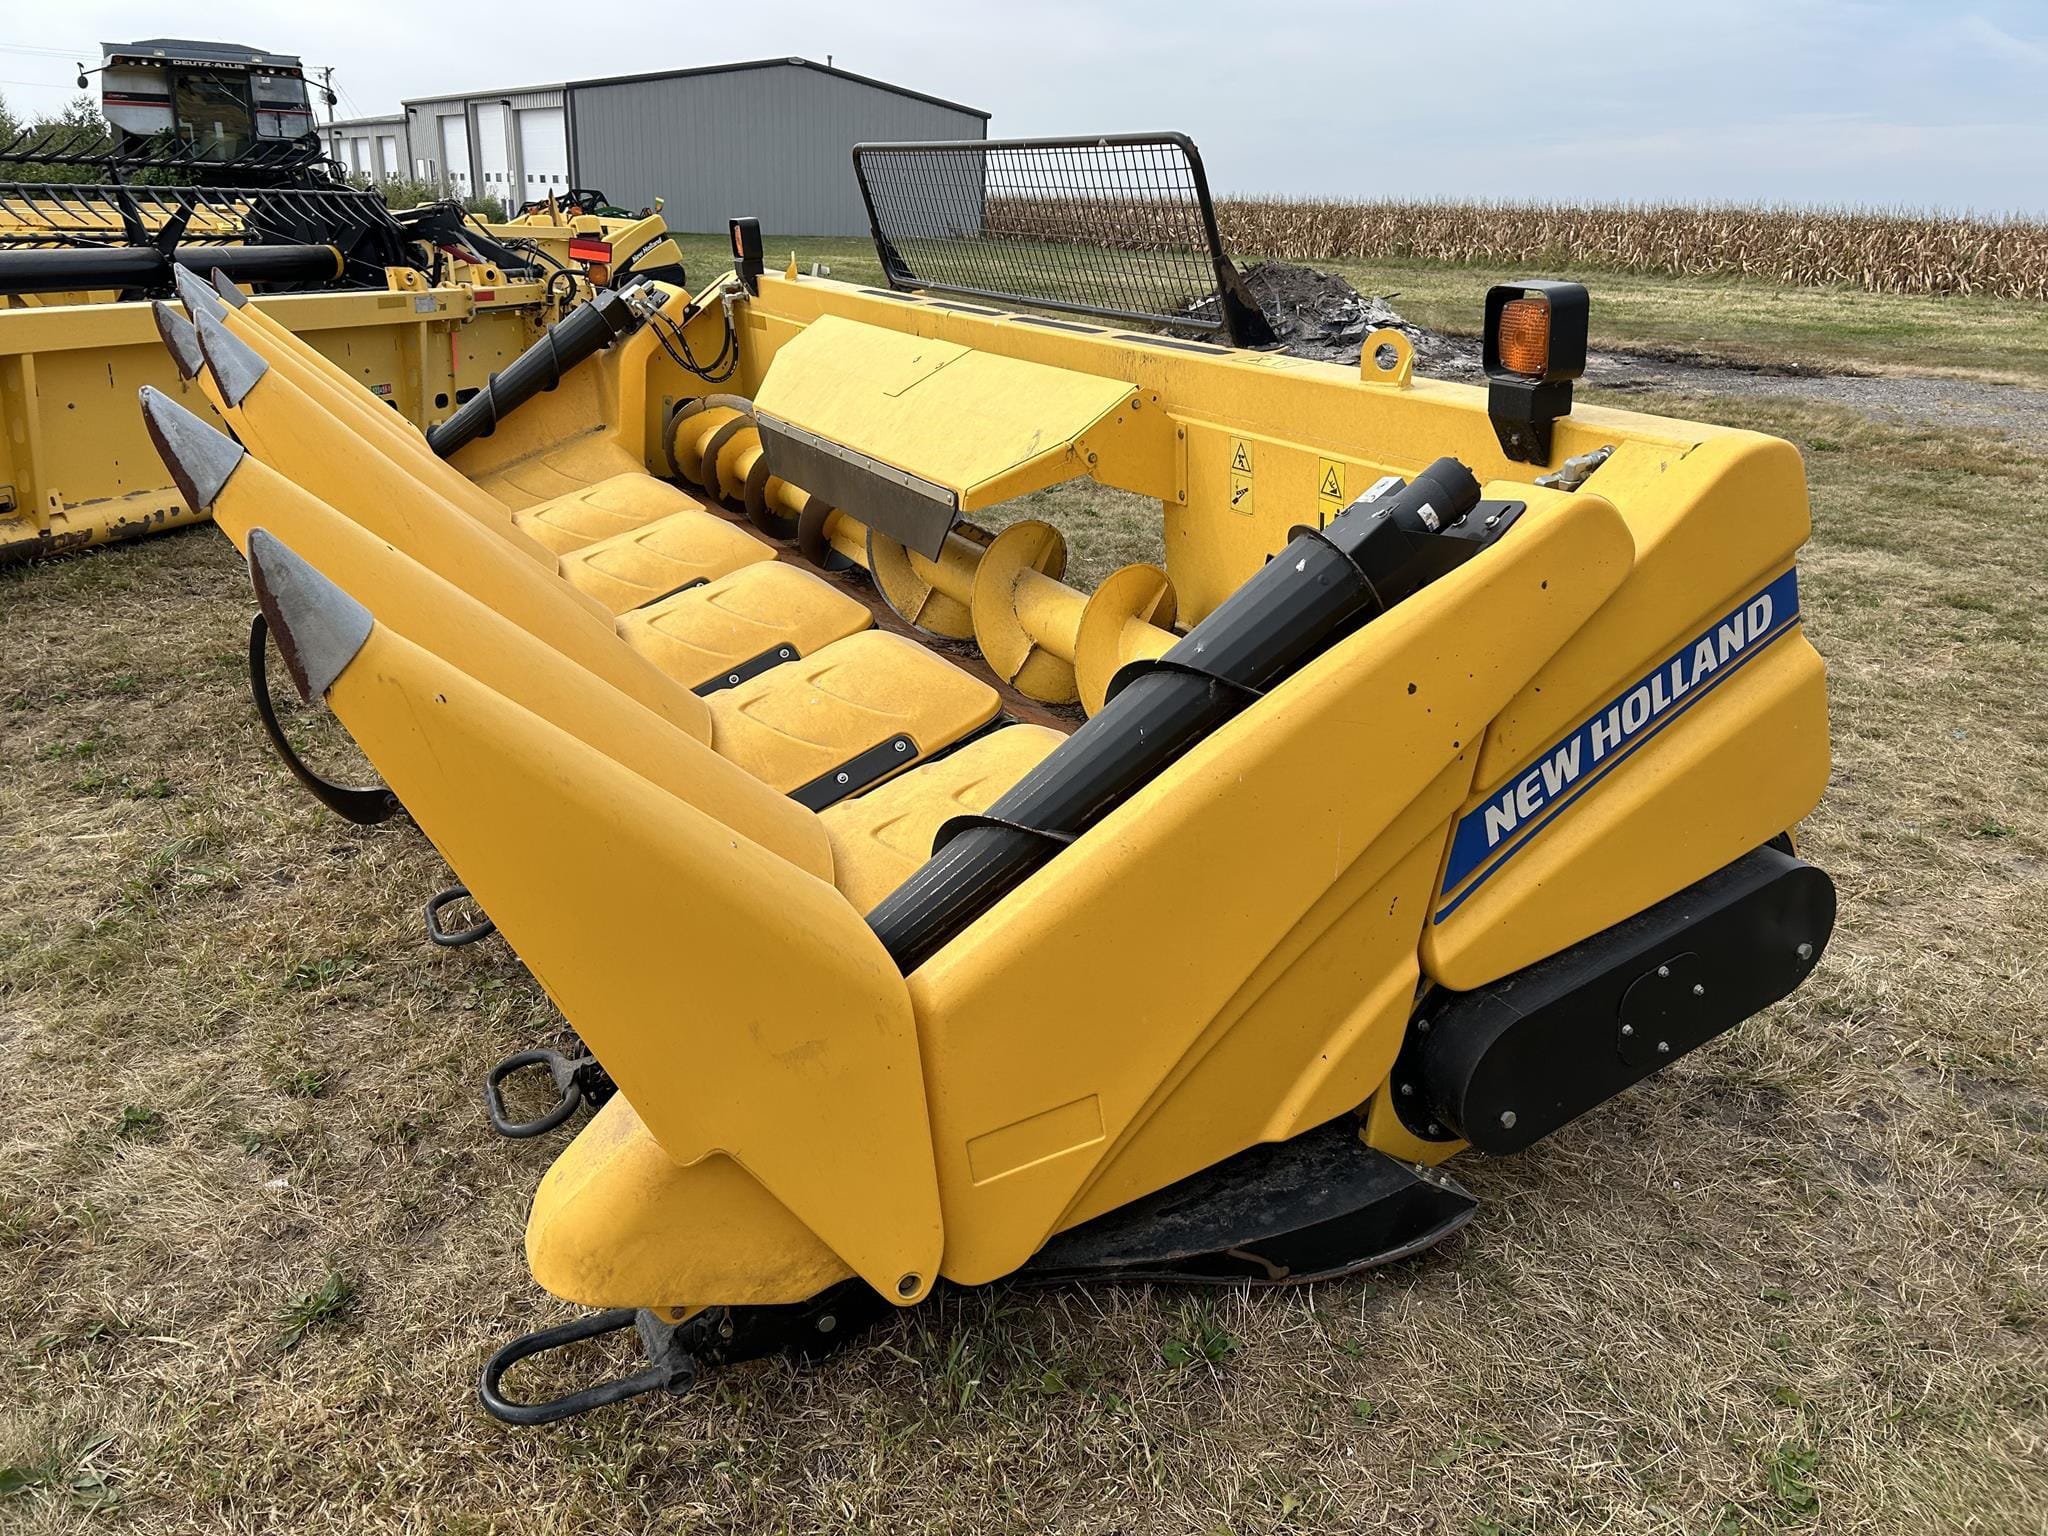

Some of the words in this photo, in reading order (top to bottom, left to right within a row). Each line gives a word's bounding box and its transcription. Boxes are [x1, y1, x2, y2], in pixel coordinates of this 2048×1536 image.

[632, 250, 643, 263] New
[642, 236, 662, 253] Holland
[1484, 735, 1581, 848] NEW
[1590, 594, 1773, 762] HOLLAND
